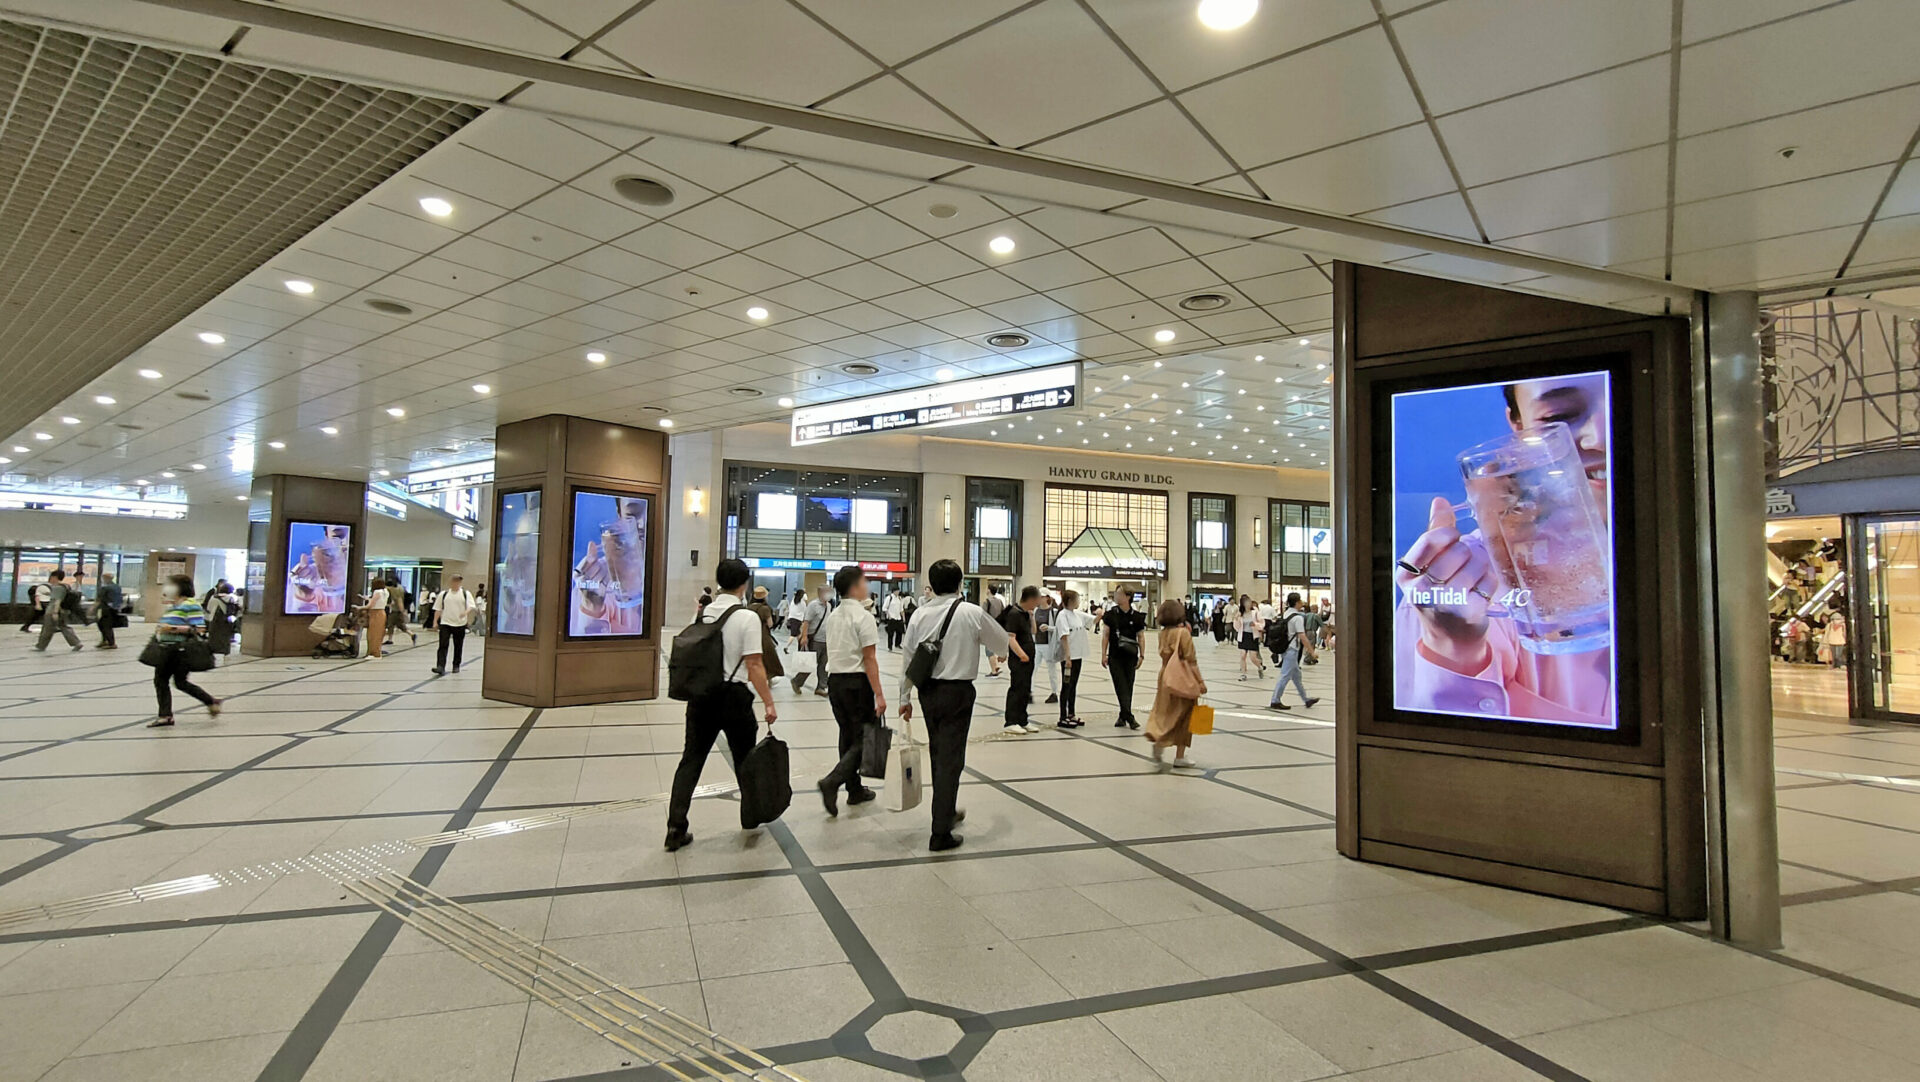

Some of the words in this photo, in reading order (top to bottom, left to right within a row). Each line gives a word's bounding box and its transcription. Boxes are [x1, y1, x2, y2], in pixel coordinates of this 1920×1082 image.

[1049, 466, 1097, 479] HANKYU
[1101, 470, 1140, 482] GRAND
[1144, 473, 1175, 485] BLDG.
